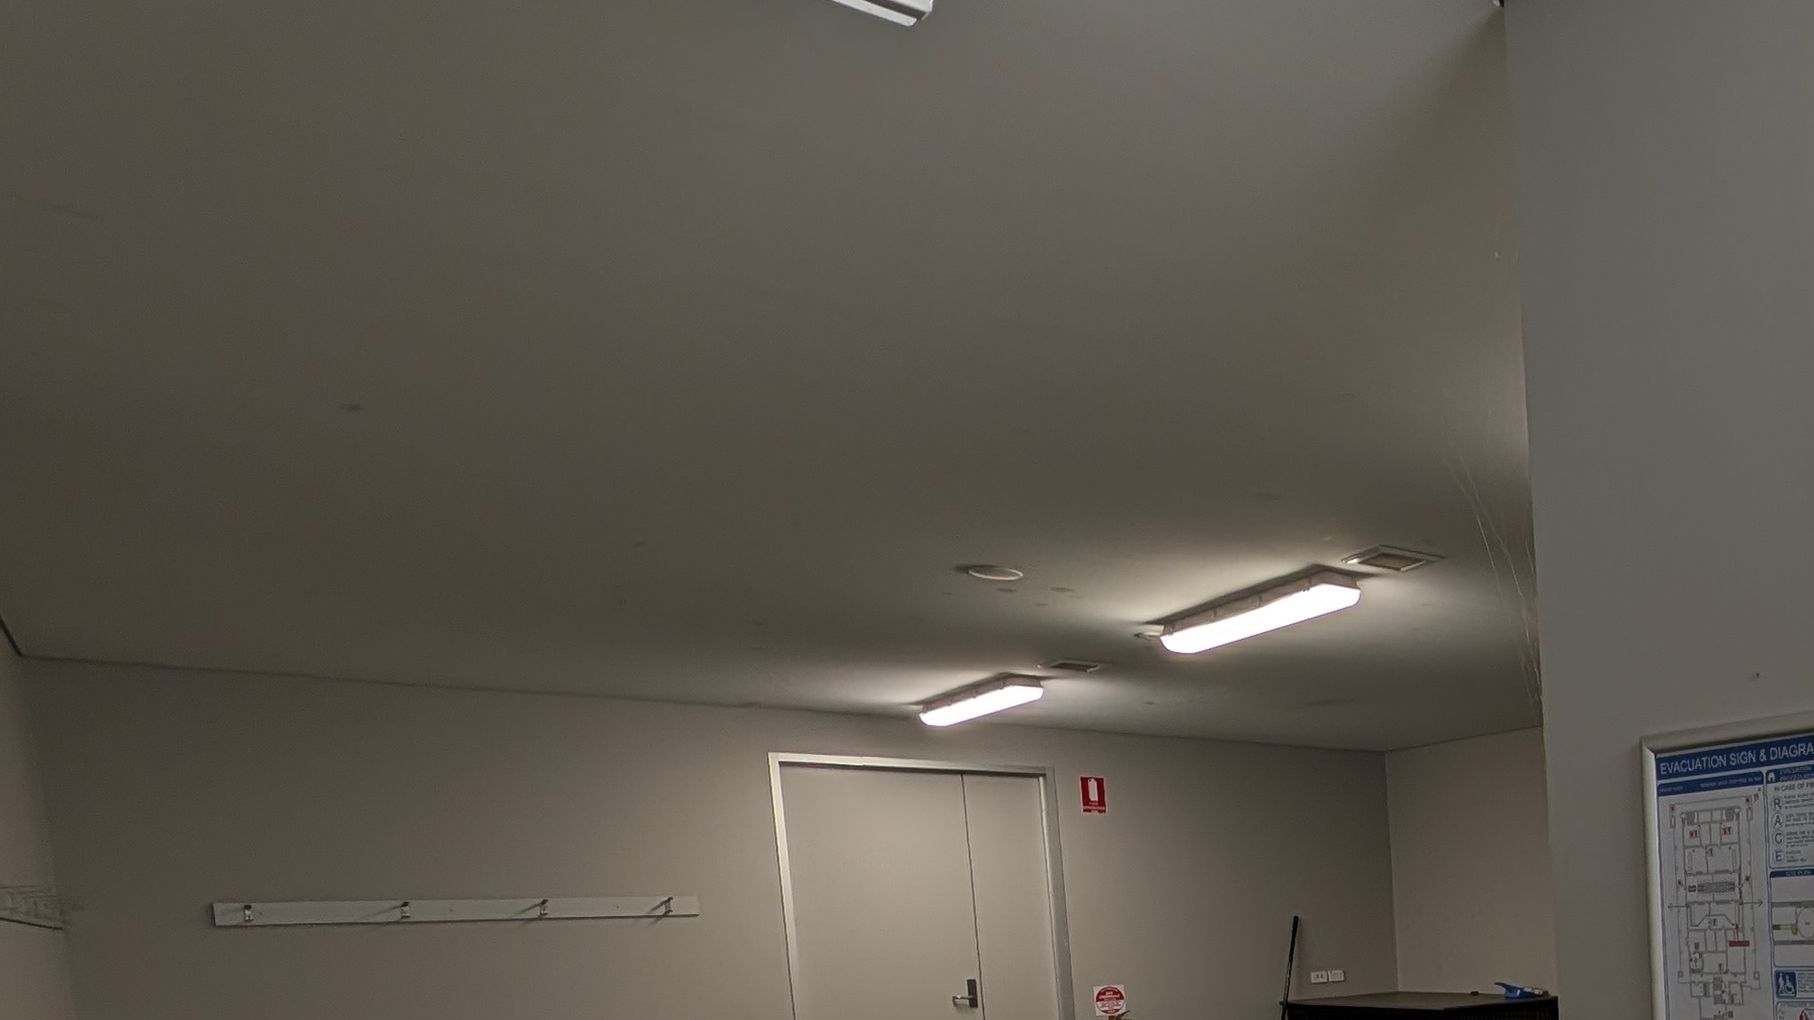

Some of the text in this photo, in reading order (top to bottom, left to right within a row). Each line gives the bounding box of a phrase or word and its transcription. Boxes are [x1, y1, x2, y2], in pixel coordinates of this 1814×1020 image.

[1660, 754, 1727, 775] EVACUATION
[1729, 751, 1756, 766] SIGN
[1758, 748, 1767, 762] &
[1774, 799, 1782, 810] R
[1774, 815, 1783, 828] A
[1775, 832, 1783, 844] C
[1776, 850, 1783, 862] E
